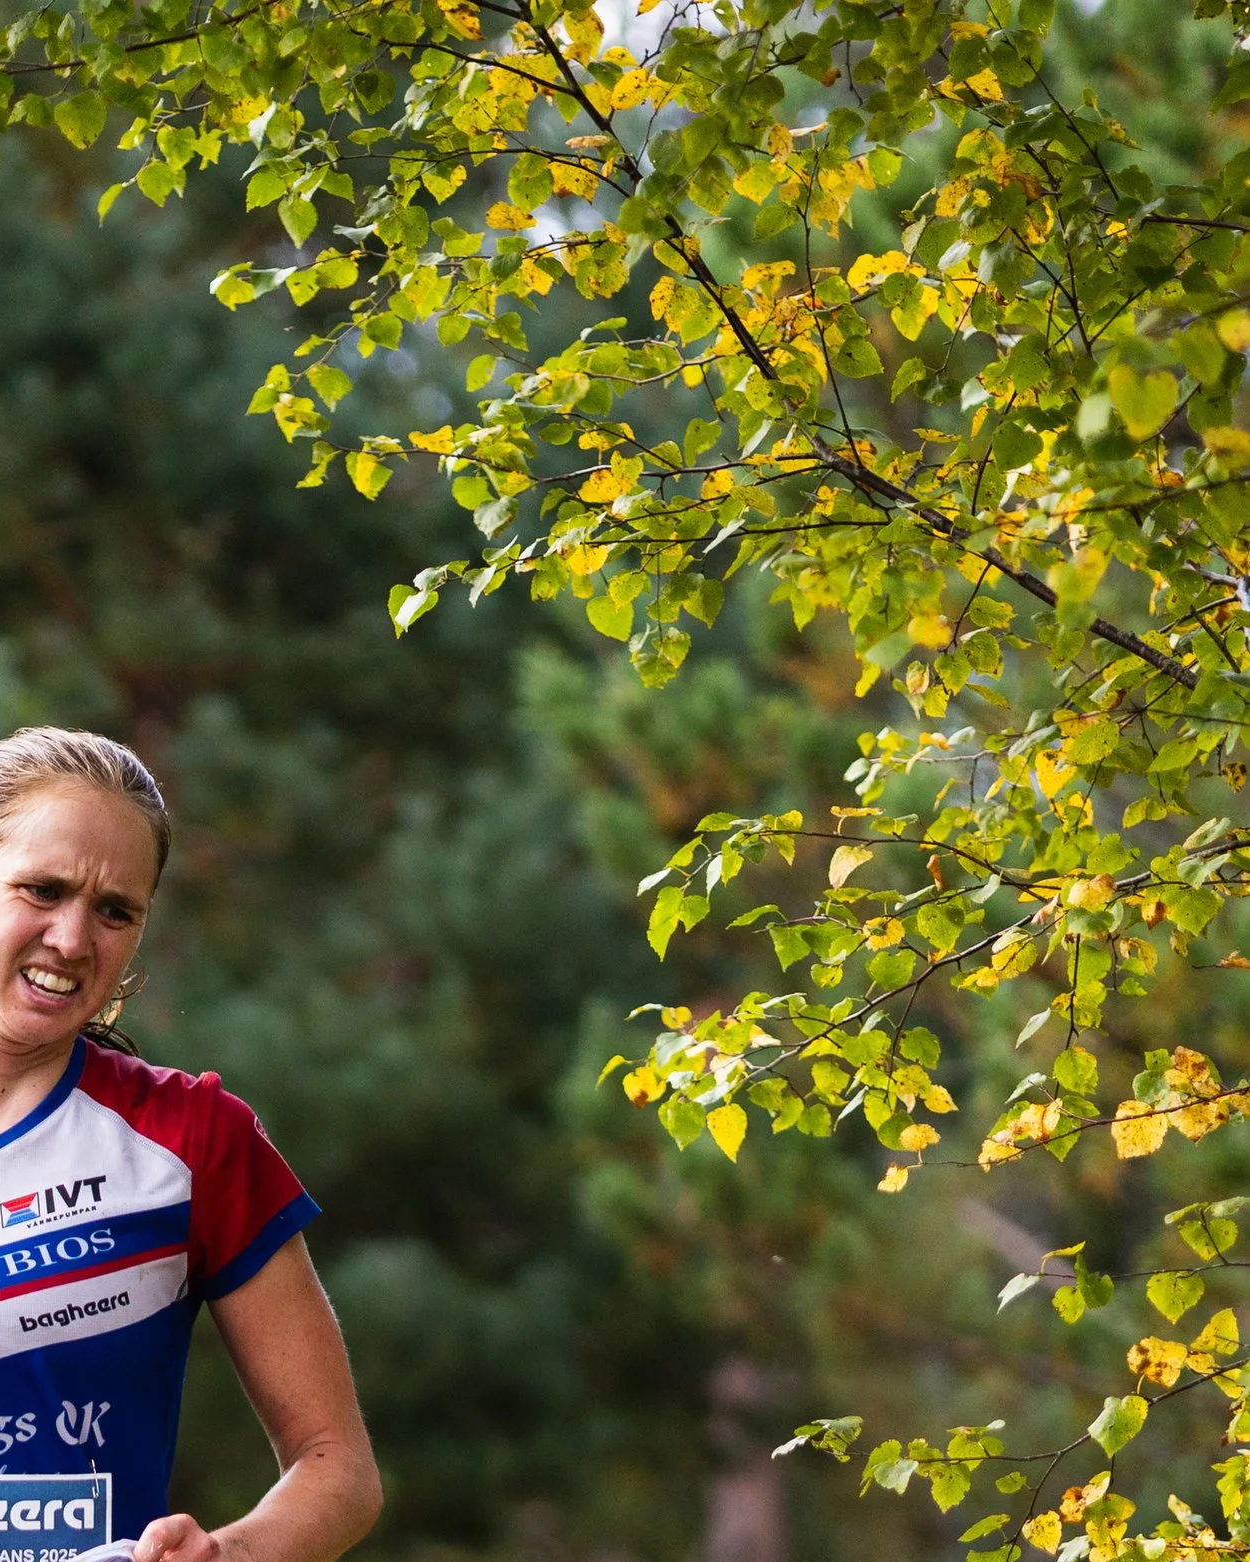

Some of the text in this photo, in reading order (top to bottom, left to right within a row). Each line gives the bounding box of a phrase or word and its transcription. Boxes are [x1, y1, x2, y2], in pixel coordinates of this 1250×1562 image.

[45, 1175, 107, 1215] IVT
[0, 1228, 116, 1277] BIOS
[19, 1291, 130, 1332] bagheera
